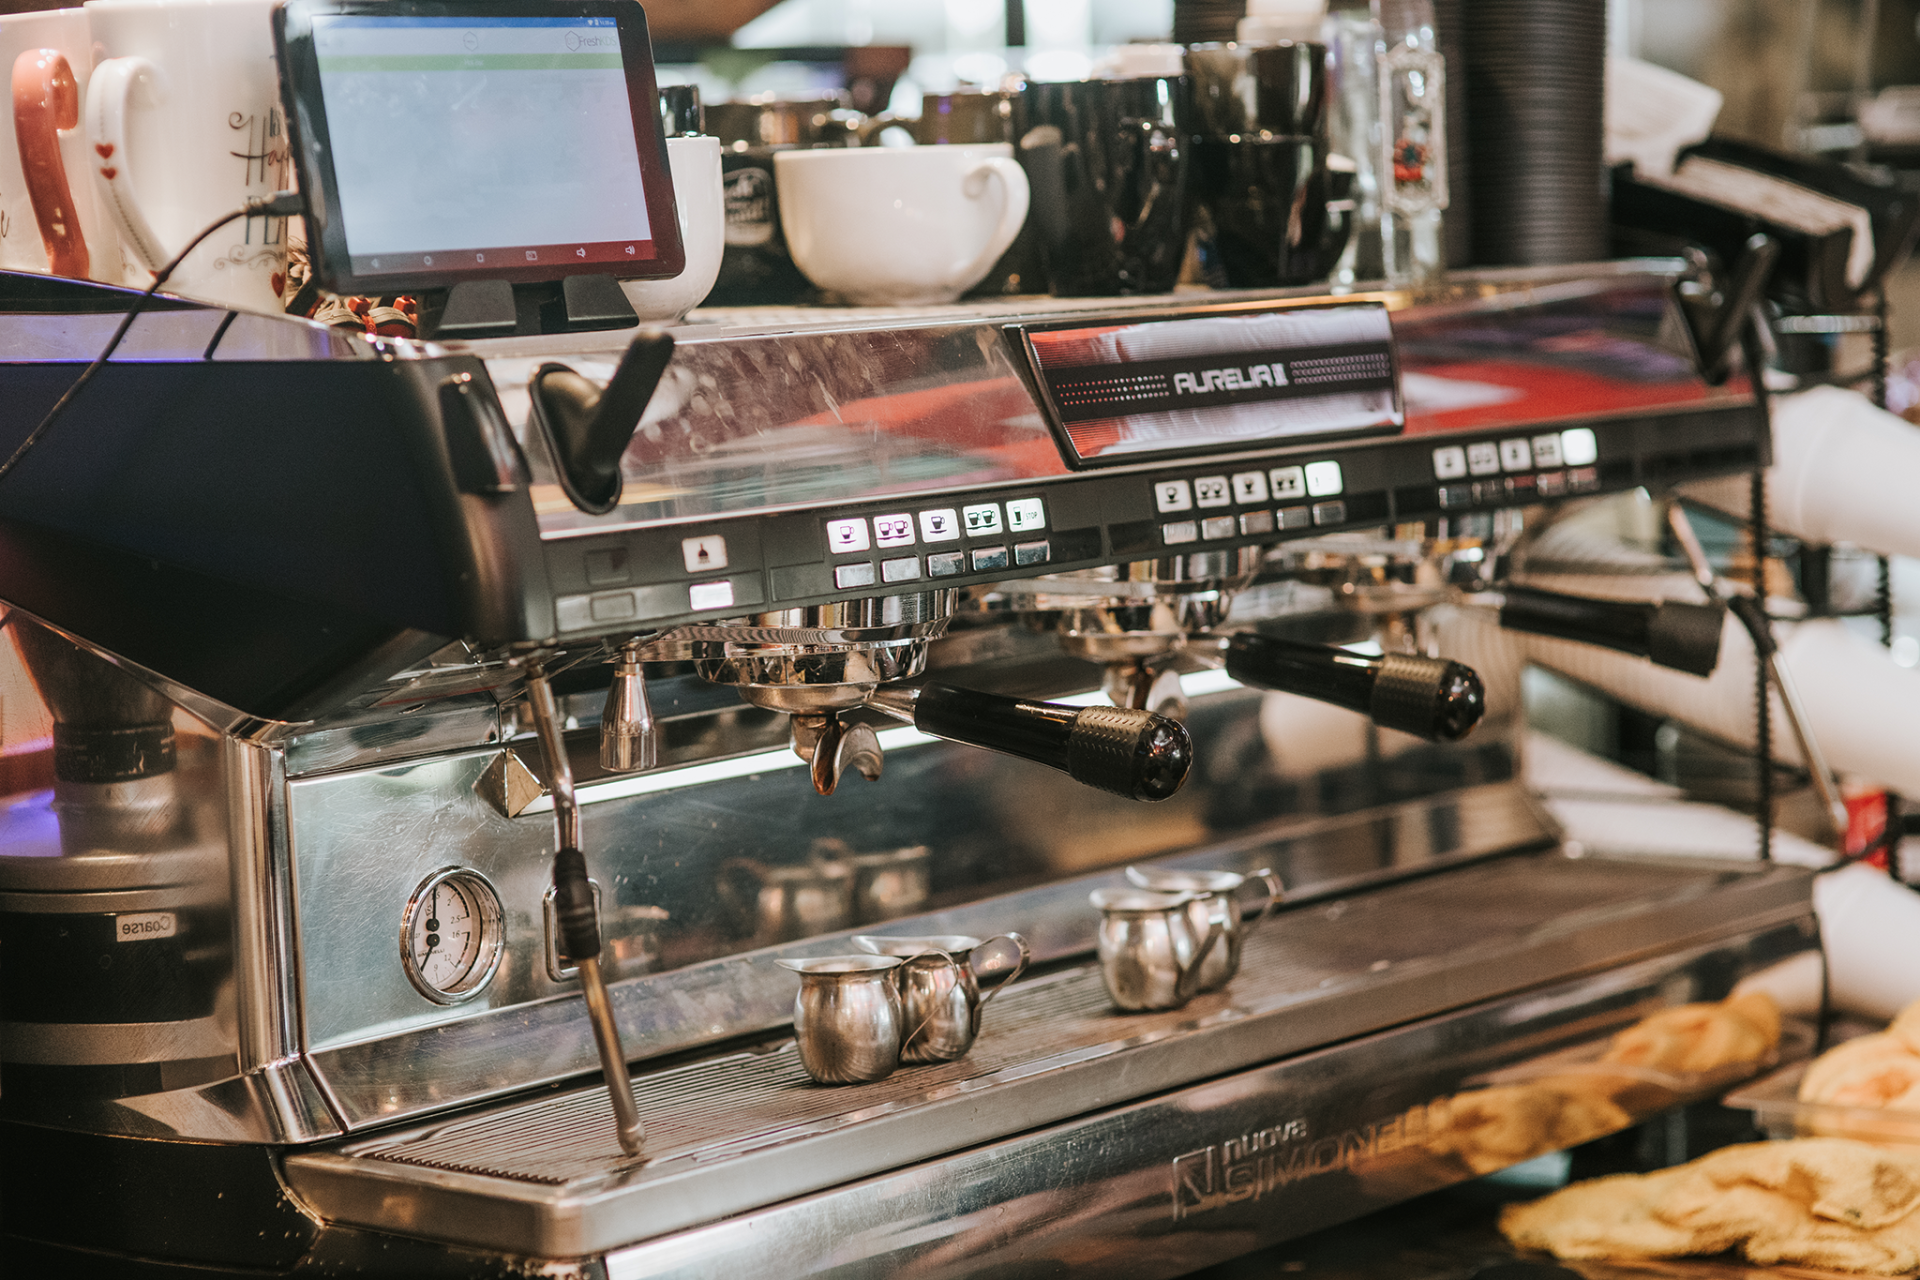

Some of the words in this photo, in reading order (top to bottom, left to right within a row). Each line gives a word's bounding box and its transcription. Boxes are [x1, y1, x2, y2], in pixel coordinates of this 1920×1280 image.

[579, 35, 617, 47] FreshKDS
[1173, 364, 1274, 395] AURELIA
[450, 916, 460, 925] 2.5
[452, 931, 461, 939] 16
[444, 953, 452, 962] 12
[433, 964, 439, 972] 9
